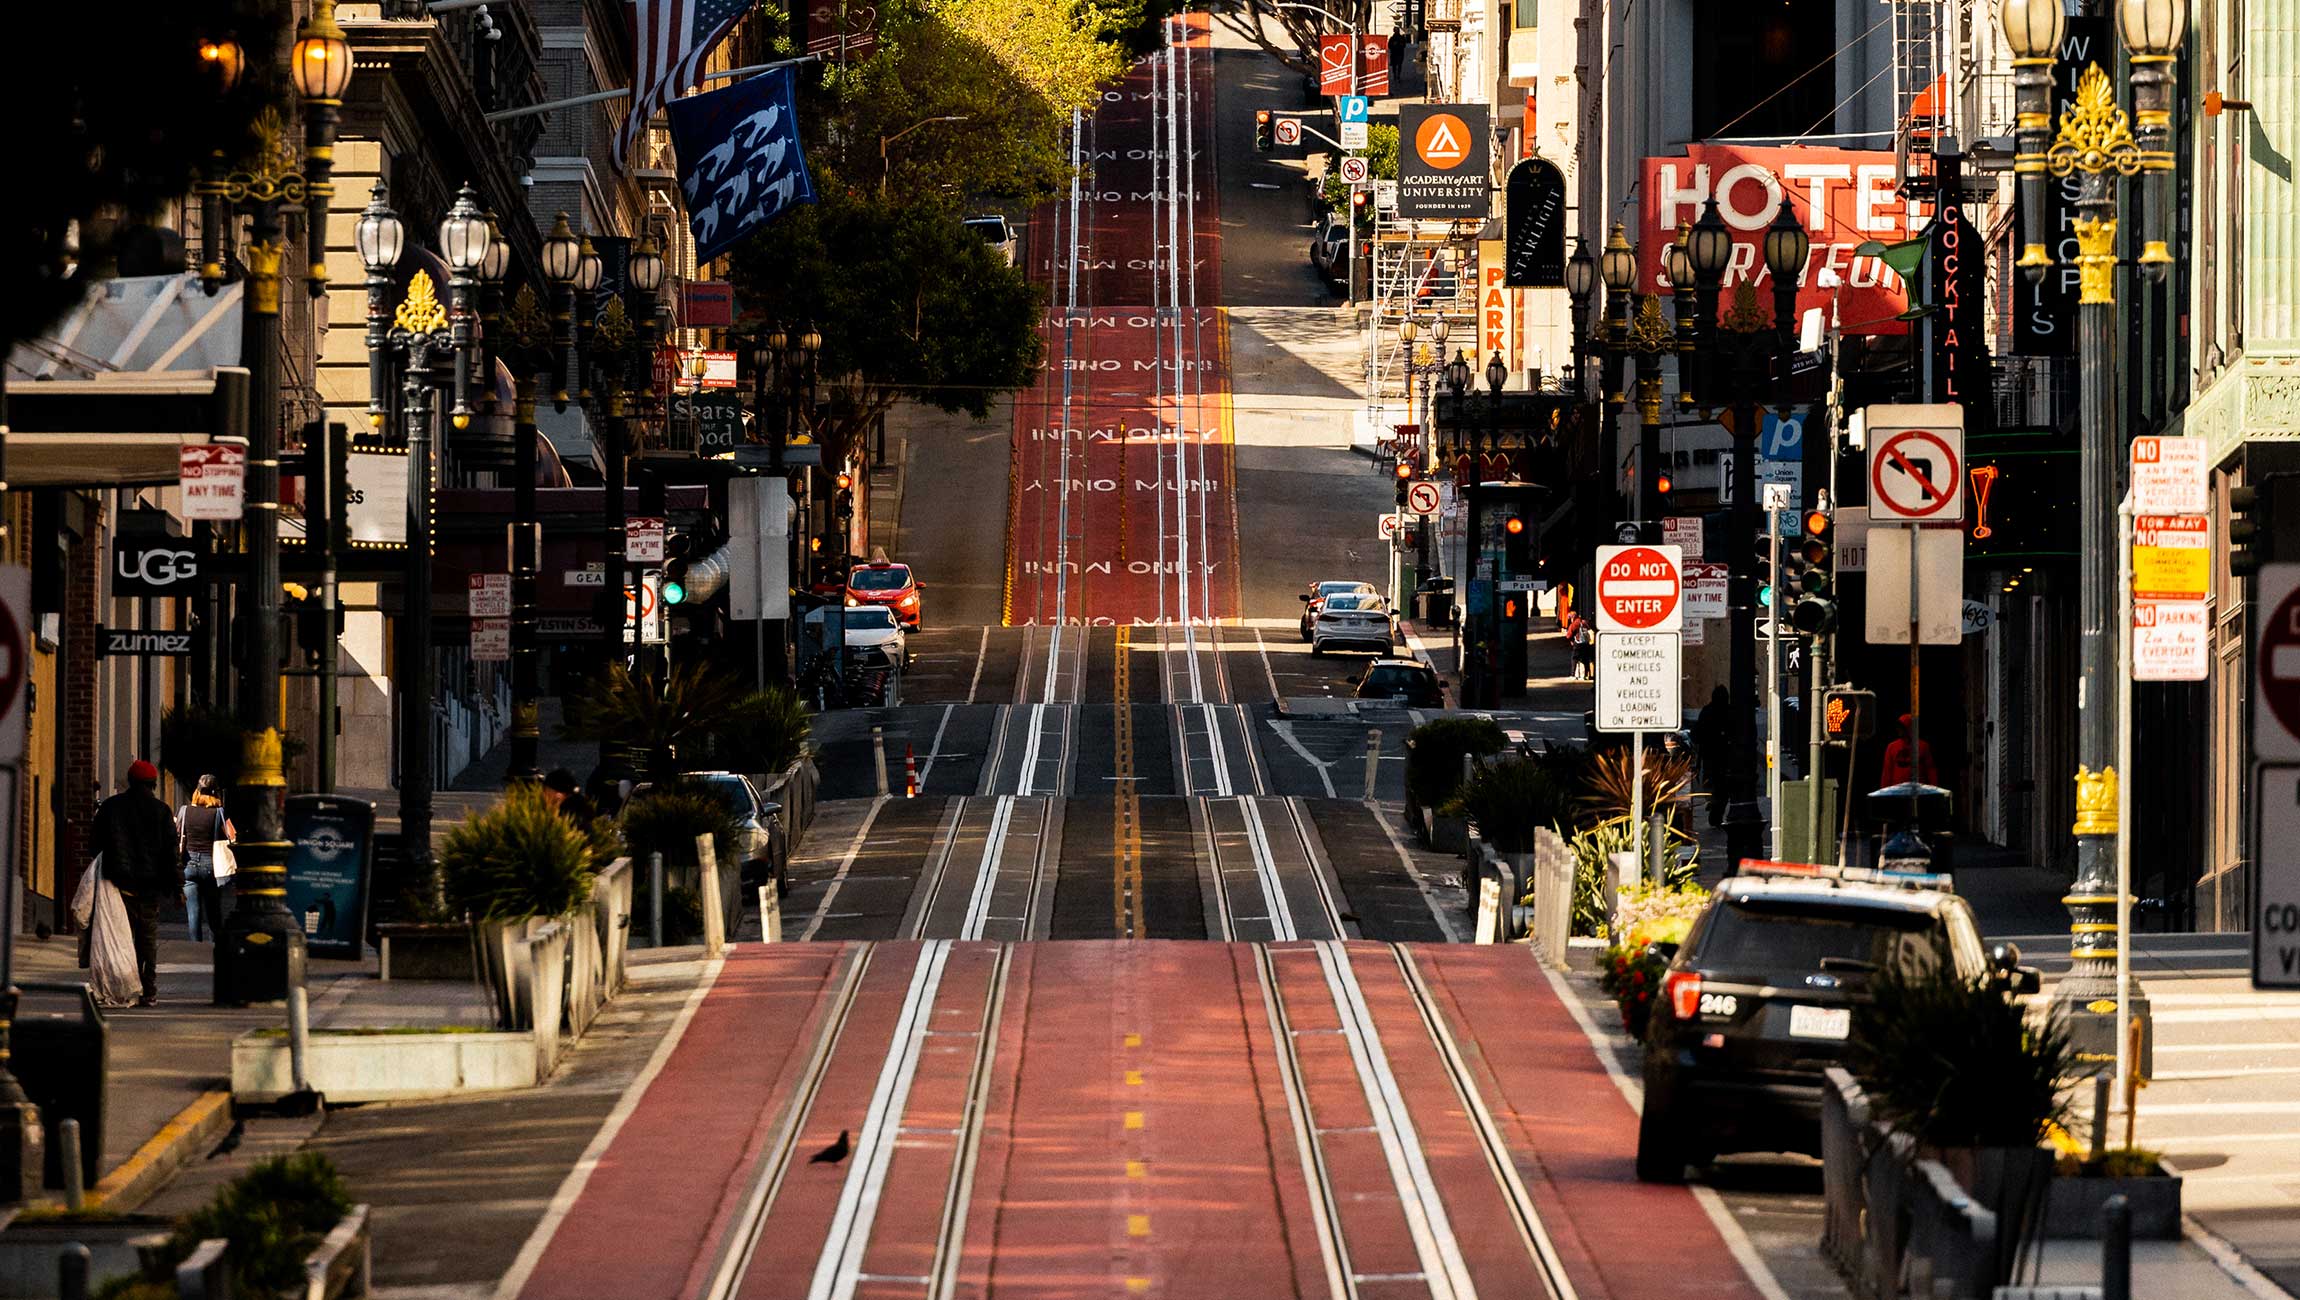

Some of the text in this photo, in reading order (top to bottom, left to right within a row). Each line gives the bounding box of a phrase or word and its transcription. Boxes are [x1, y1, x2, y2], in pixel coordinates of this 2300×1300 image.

[1403, 176, 1455, 185] ACADEMY
[1463, 176, 1484, 185] ART
[1403, 187, 1484, 197] UNIVERSITY
[1511, 188, 1560, 280] STARLIGHT
[2136, 441, 2157, 461] NO
[183, 466, 202, 477] NO
[188, 485, 236, 496] ANY TIME
[2144, 498, 2197, 506] INCLUDED
[1664, 518, 1676, 531] NO
[2140, 517, 2201, 530] TOW-AWAY
[2137, 530, 2202, 546] NO STOPPING
[118, 549, 197, 585] UGG
[2143, 558, 2196, 566] COMMERCIAL
[1610, 563, 1667, 577] DO NOT
[471, 577, 484, 588] NO
[576, 574, 603, 582] GEA
[1683, 580, 1726, 588] NO STOPPING
[1687, 594, 1722, 602] ANY TIME
[1615, 599, 1662, 613] ENTER
[2135, 605, 2203, 626] NO PARKING
[109, 634, 190, 651] zumiez
[1621, 636, 1656, 645] EXCEPT
[1612, 649, 1665, 658] COMMERCIAL
[2142, 647, 2196, 657] EVERYDAY
[1617, 663, 1661, 672] VEHICLES
[1629, 676, 1648, 685] AND
[1617, 689, 1661, 699] VEHICLES
[1620, 703, 1657, 712] LOADING
[1612, 717, 1665, 725] ON POWELL
[1699, 993, 1737, 1016] 246
